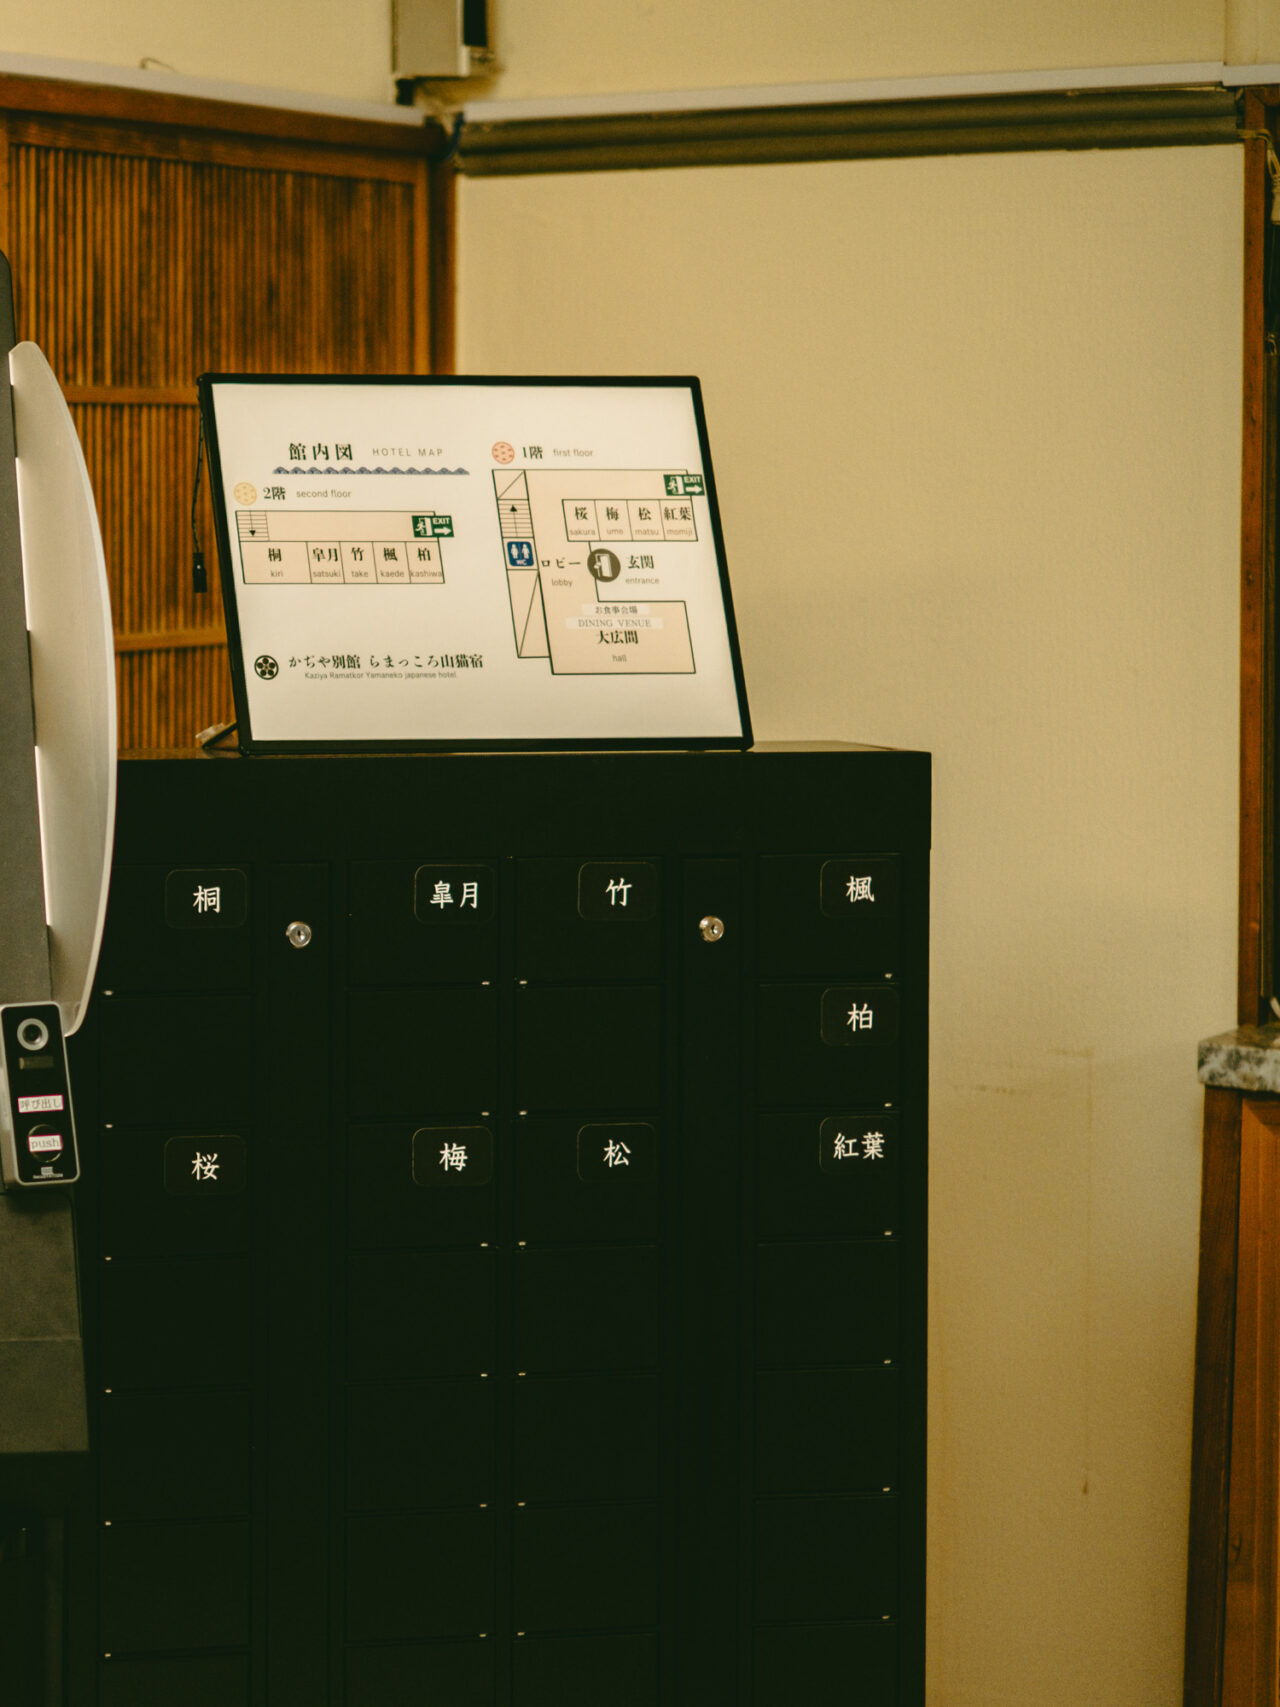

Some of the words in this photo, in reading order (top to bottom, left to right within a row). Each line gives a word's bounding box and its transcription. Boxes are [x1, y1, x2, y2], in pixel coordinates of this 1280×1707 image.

[289, 443, 353, 461] 館内図
[372, 448, 411, 457] HOTEL
[418, 448, 444, 457] MAP
[523, 446, 543, 460] 1階
[553, 448, 570, 457] first
[573, 448, 594, 457] floor
[684, 476, 701, 484] EXIT
[263, 486, 286, 500] 2階
[296, 489, 328, 498] second
[330, 489, 352, 498] floor
[432, 517, 450, 525] EXIT
[575, 507, 588, 521] 桜
[606, 507, 619, 521] 梅
[638, 507, 652, 521] 松
[663, 507, 692, 521] 紅葉
[268, 548, 282, 562] 桐
[312, 548, 339, 562] 皐月
[351, 547, 364, 561] 竹
[383, 547, 398, 562] 楓
[418, 547, 431, 561] 柏
[541, 558, 581, 569] ロビー
[628, 555, 655, 570] 玄関
[270, 569, 284, 578] kiri
[313, 569, 341, 578] satsuki
[351, 569, 369, 578] take
[380, 569, 405, 578] kaede
[410, 569, 443, 578] kashiwa
[551, 578, 573, 588] lobby
[625, 577, 660, 585] entrance
[595, 605, 638, 615] お食事会場
[578, 619, 613, 628] DINING
[619, 619, 652, 628] VENUE
[597, 630, 639, 645] 大広間
[289, 654, 361, 669] かぢや別館
[369, 653, 484, 669] らまっころ山猫宿
[612, 654, 627, 662] hall
[366, 671, 403, 679] Yamaneko
[405, 671, 436, 680] japanese
[438, 671, 456, 679] hotel
[430, 881, 477, 909] 皐月
[606, 878, 632, 906] 竹
[846, 876, 874, 902] 楓
[193, 886, 220, 913] 桐
[847, 1003, 872, 1031] 柏
[19, 1098, 61, 1111] 呼び出し
[30, 1138, 61, 1149] push
[834, 1132, 884, 1159] 紅葉
[440, 1143, 467, 1171] 梅
[604, 1140, 631, 1167] 松
[192, 1152, 219, 1180] 桜
